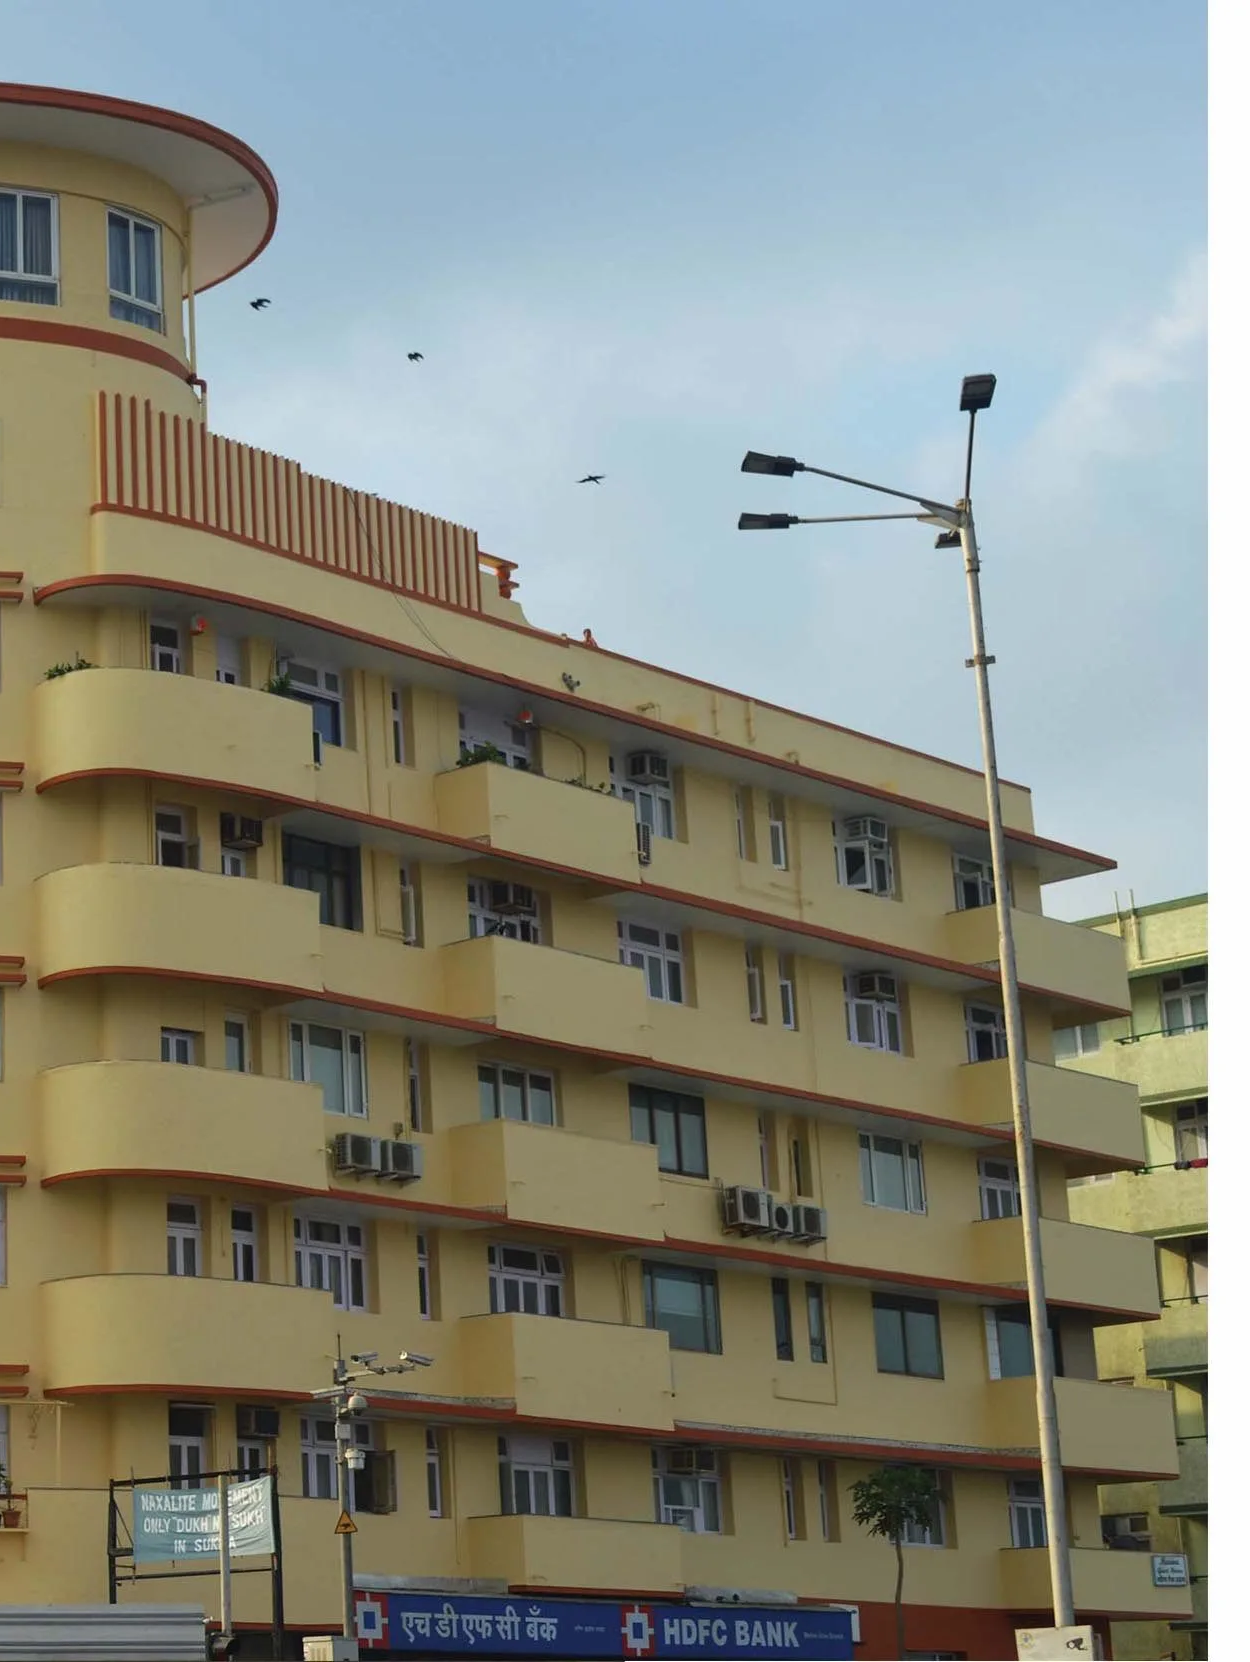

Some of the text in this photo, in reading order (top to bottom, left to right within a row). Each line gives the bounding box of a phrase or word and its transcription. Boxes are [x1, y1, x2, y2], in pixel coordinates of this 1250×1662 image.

[141, 1485, 264, 1512] NAXALITE MOEMENT
[143, 1517, 170, 1533] ONLY
[174, 1536, 237, 1553] IN SUKA
[663, 1618, 800, 1648] HDFC BANK
